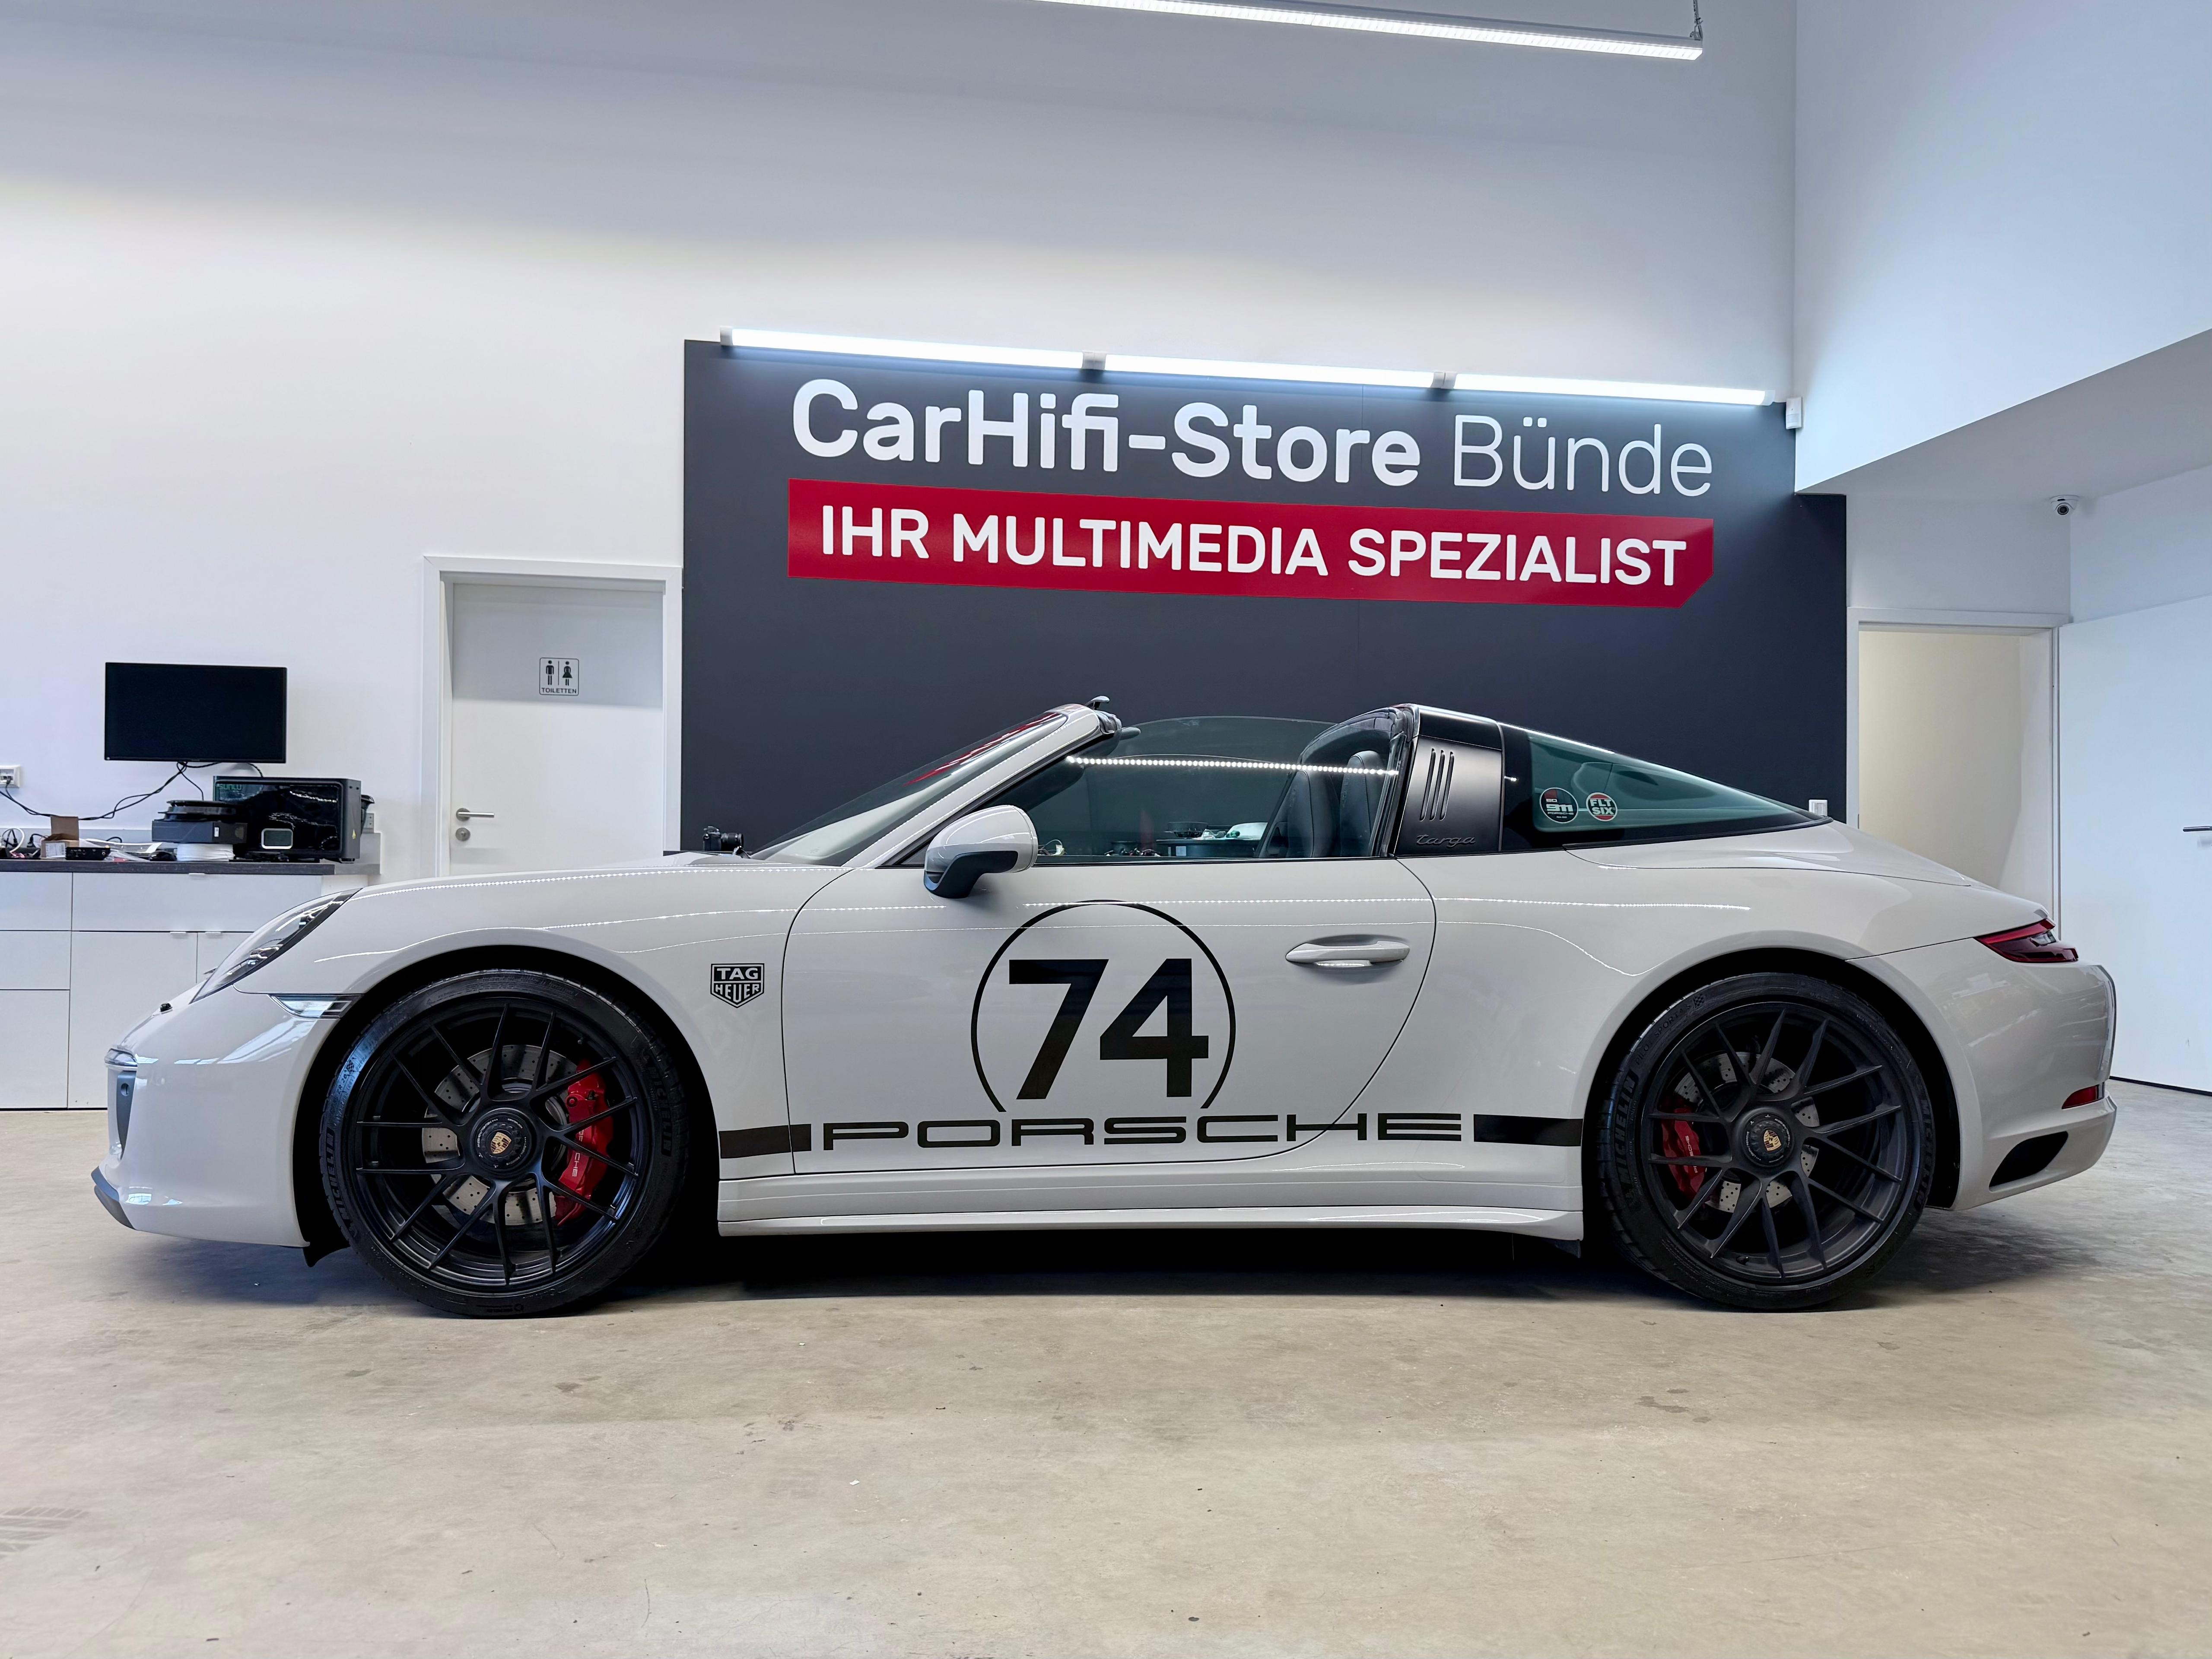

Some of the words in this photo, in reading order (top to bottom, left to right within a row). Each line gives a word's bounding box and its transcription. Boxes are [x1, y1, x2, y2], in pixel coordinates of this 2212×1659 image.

[793, 379, 1420, 486] CarHifi-Store
[1454, 414, 1712, 496] Bünde
[823, 505, 929, 559] IHR
[953, 513, 1328, 576] MULTIMEDIA
[1348, 528, 1687, 586] SPEZIALIST
[1592, 807, 1615, 815] SIX
[1416, 834, 1476, 848] targa
[715, 984, 760, 1003] HEUER
[717, 967, 758, 980] TAG
[1009, 958, 1209, 1100] 74
[823, 1113, 1462, 1150] PORSCHE
[1615, 1074, 1636, 1184] MICHELIN
[326, 1132, 350, 1220] MICHELIN
